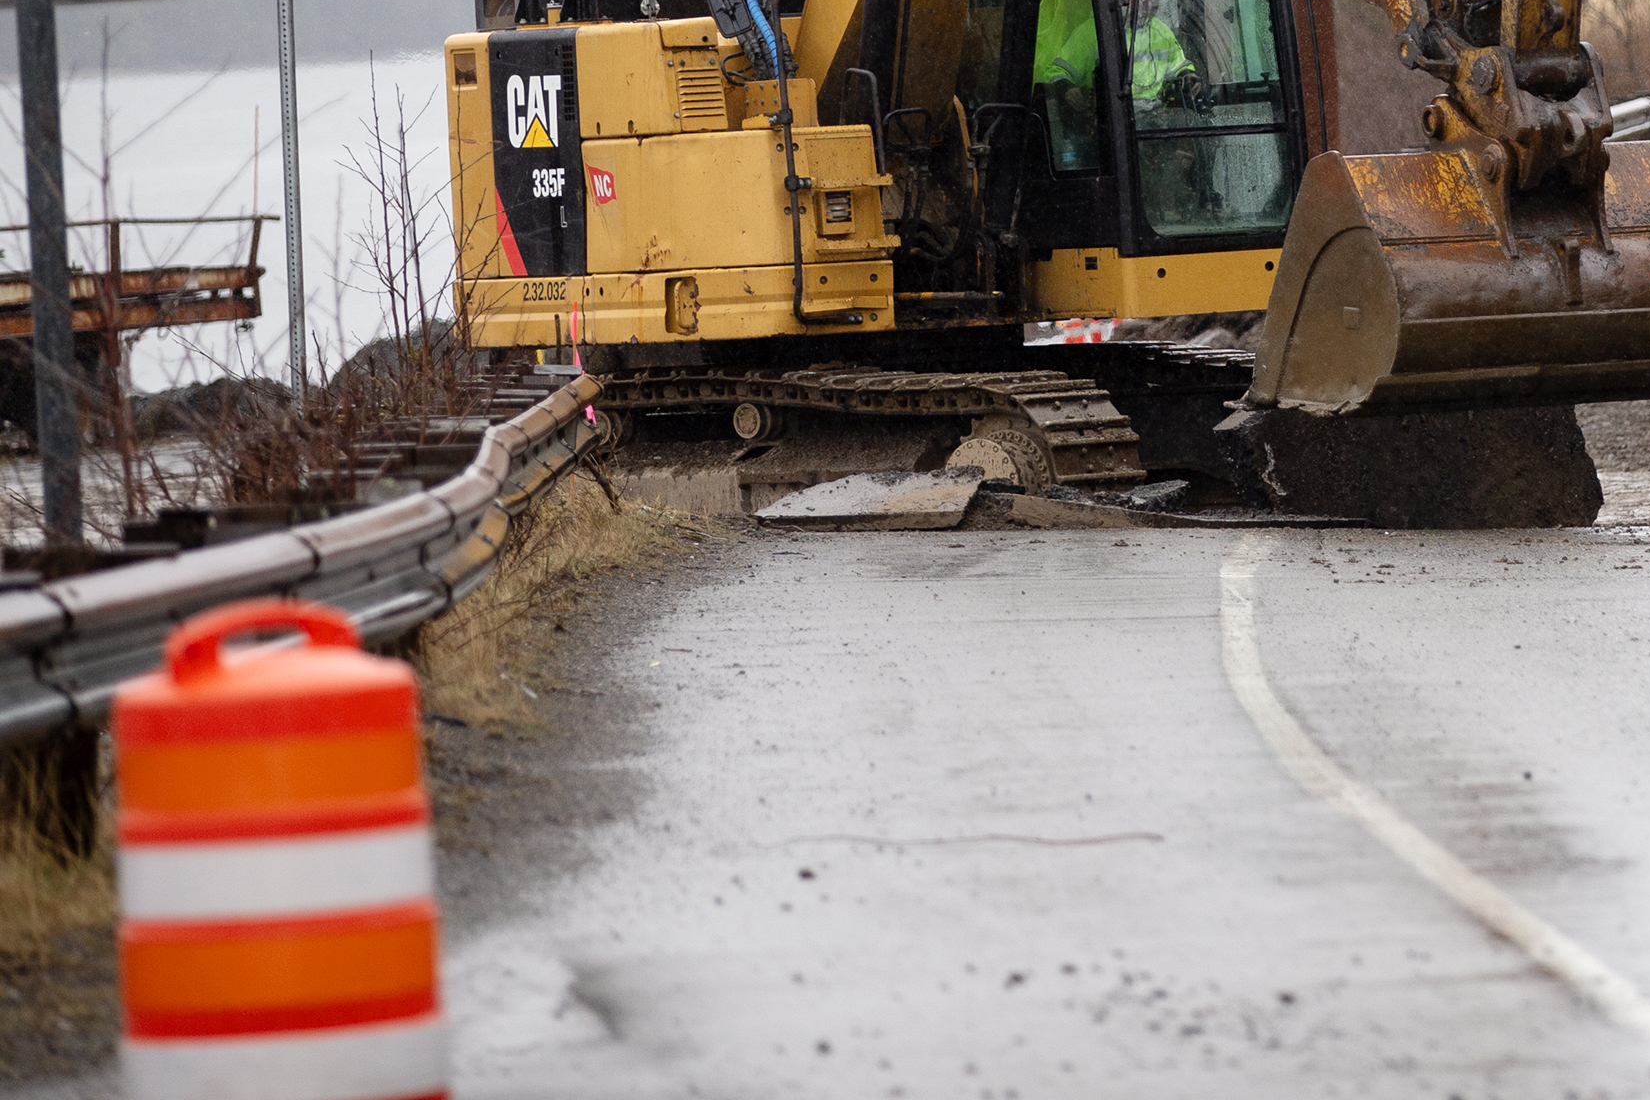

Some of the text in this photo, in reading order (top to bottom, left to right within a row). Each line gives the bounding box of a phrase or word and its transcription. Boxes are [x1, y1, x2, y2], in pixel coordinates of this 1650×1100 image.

[506, 74, 561, 148] CAT
[532, 168, 566, 198] 335F
[593, 174, 613, 197] NC
[522, 281, 567, 302] 2.32.032
